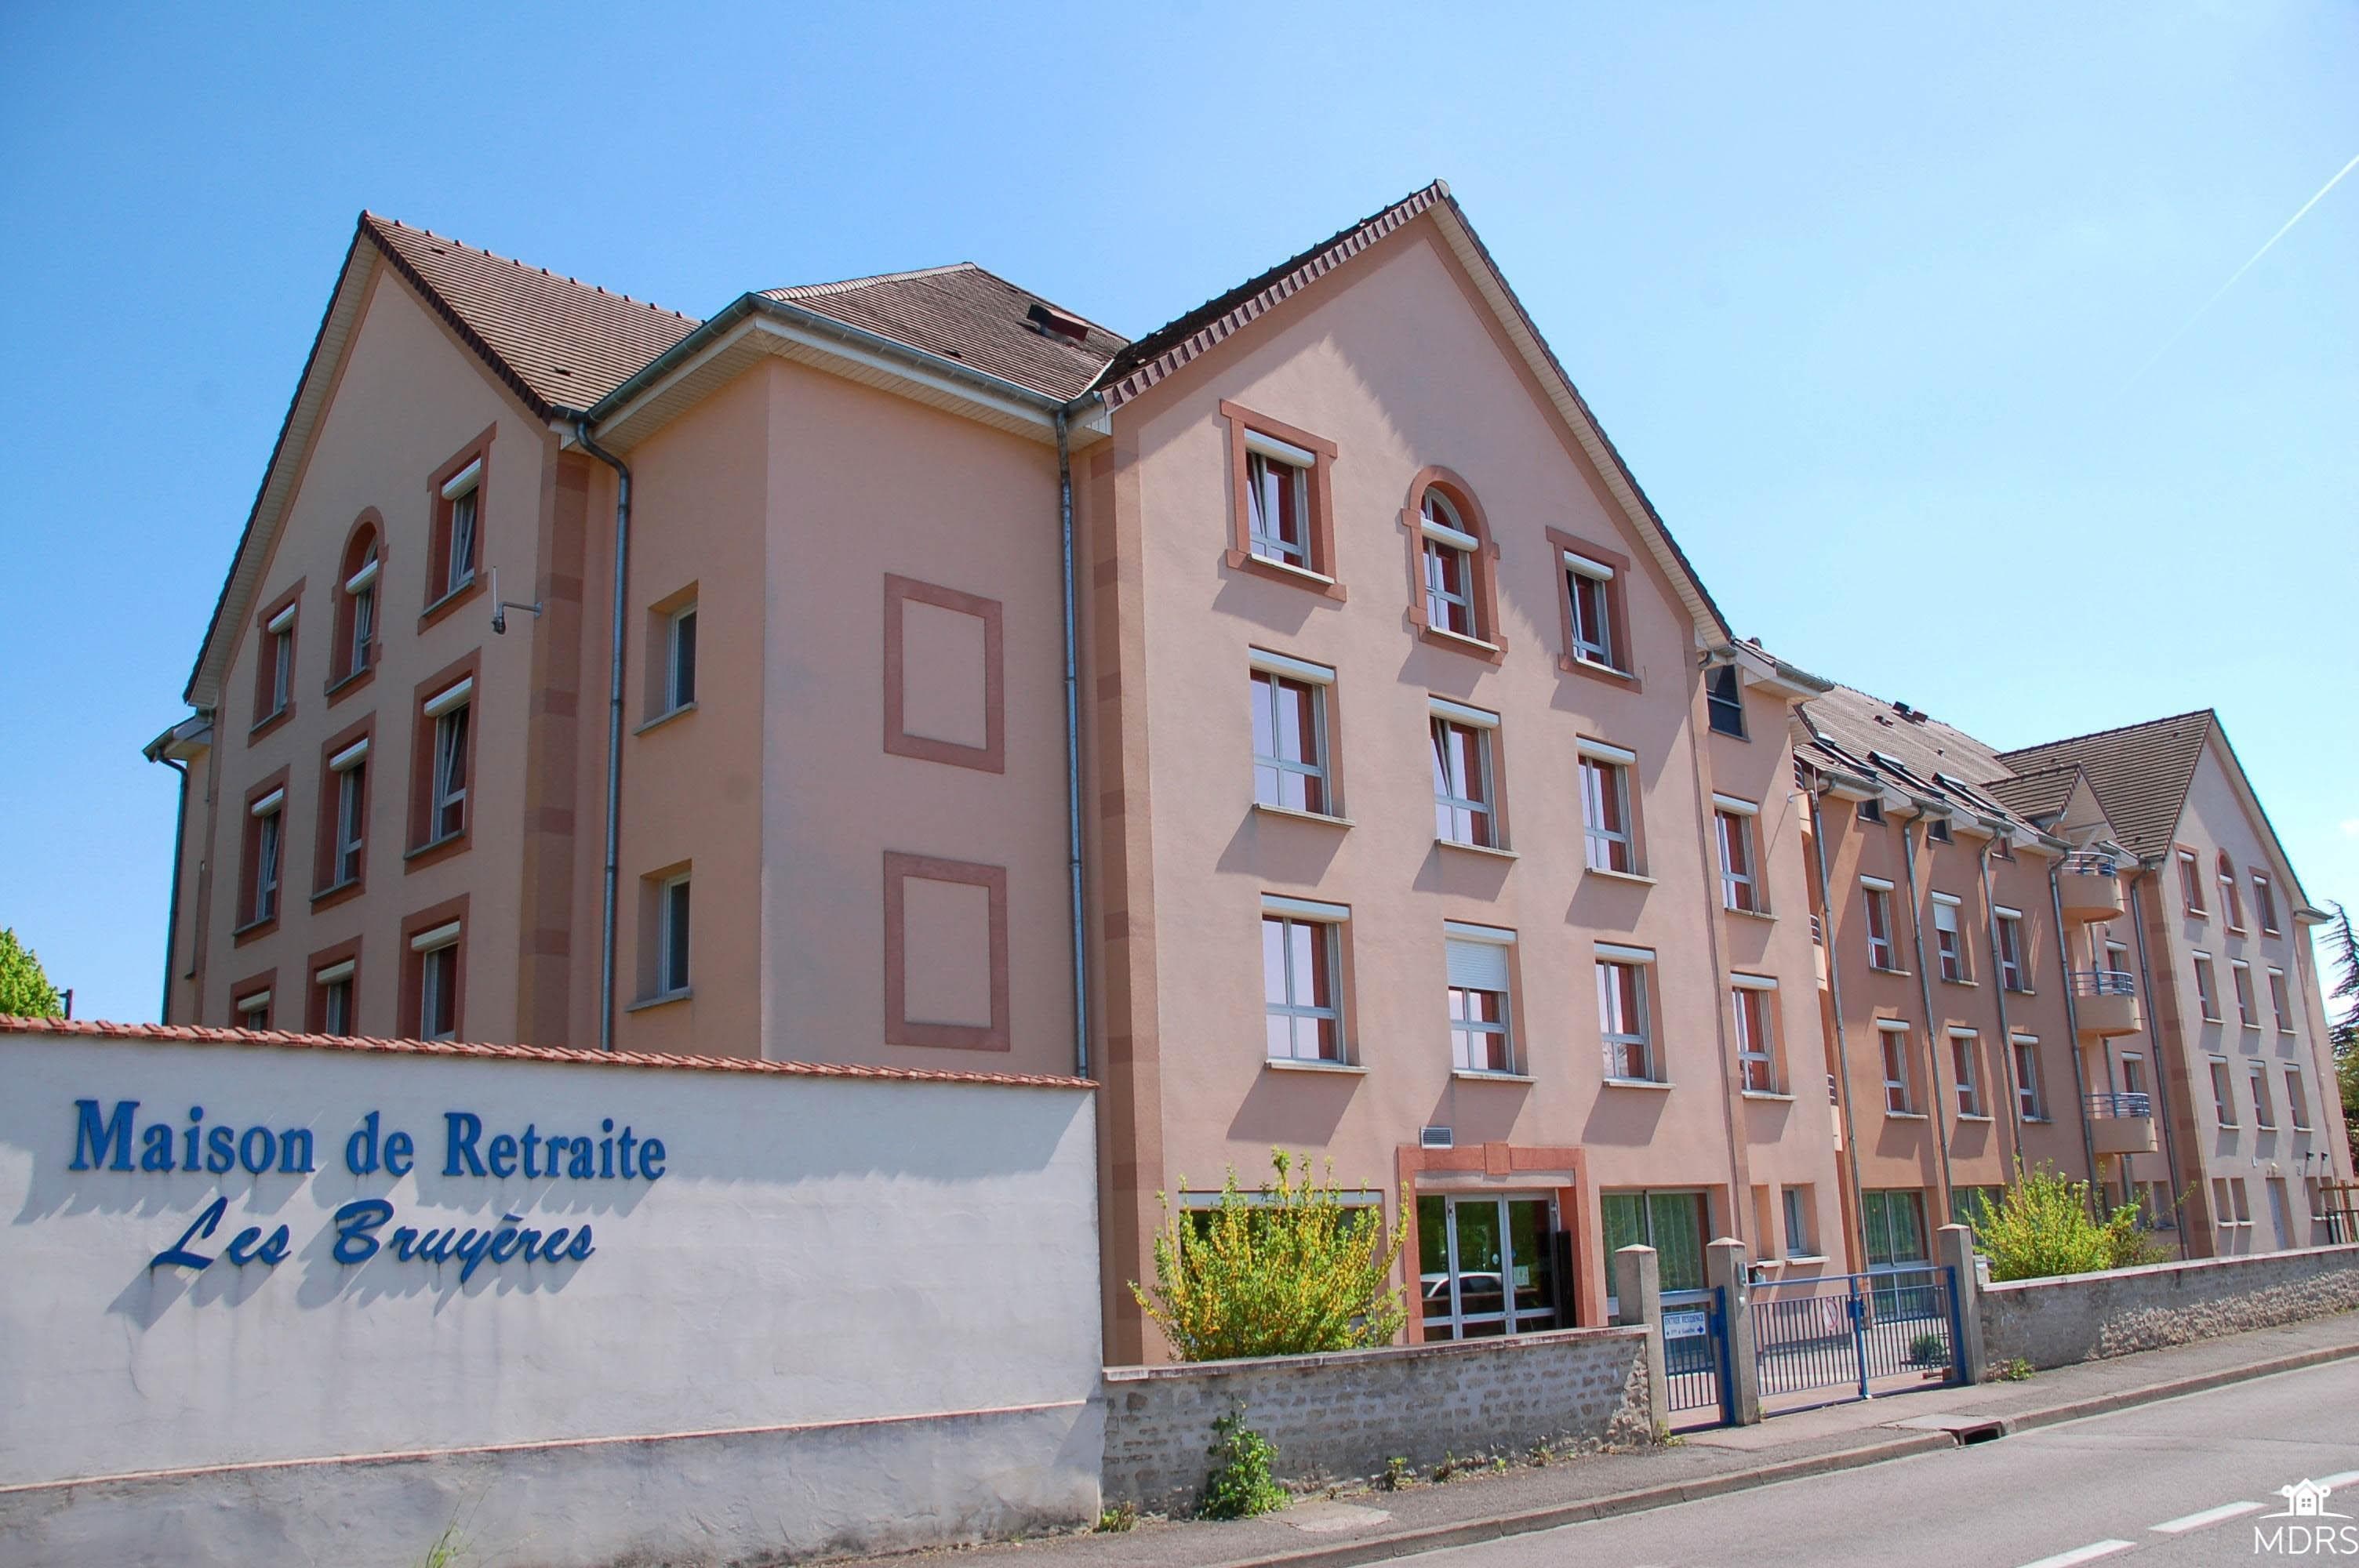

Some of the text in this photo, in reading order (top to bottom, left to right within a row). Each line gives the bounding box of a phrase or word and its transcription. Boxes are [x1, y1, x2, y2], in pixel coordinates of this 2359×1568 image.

[69, 1098, 667, 1181] Maison de Retraite
[150, 1196, 596, 1284] Les Bruyères
